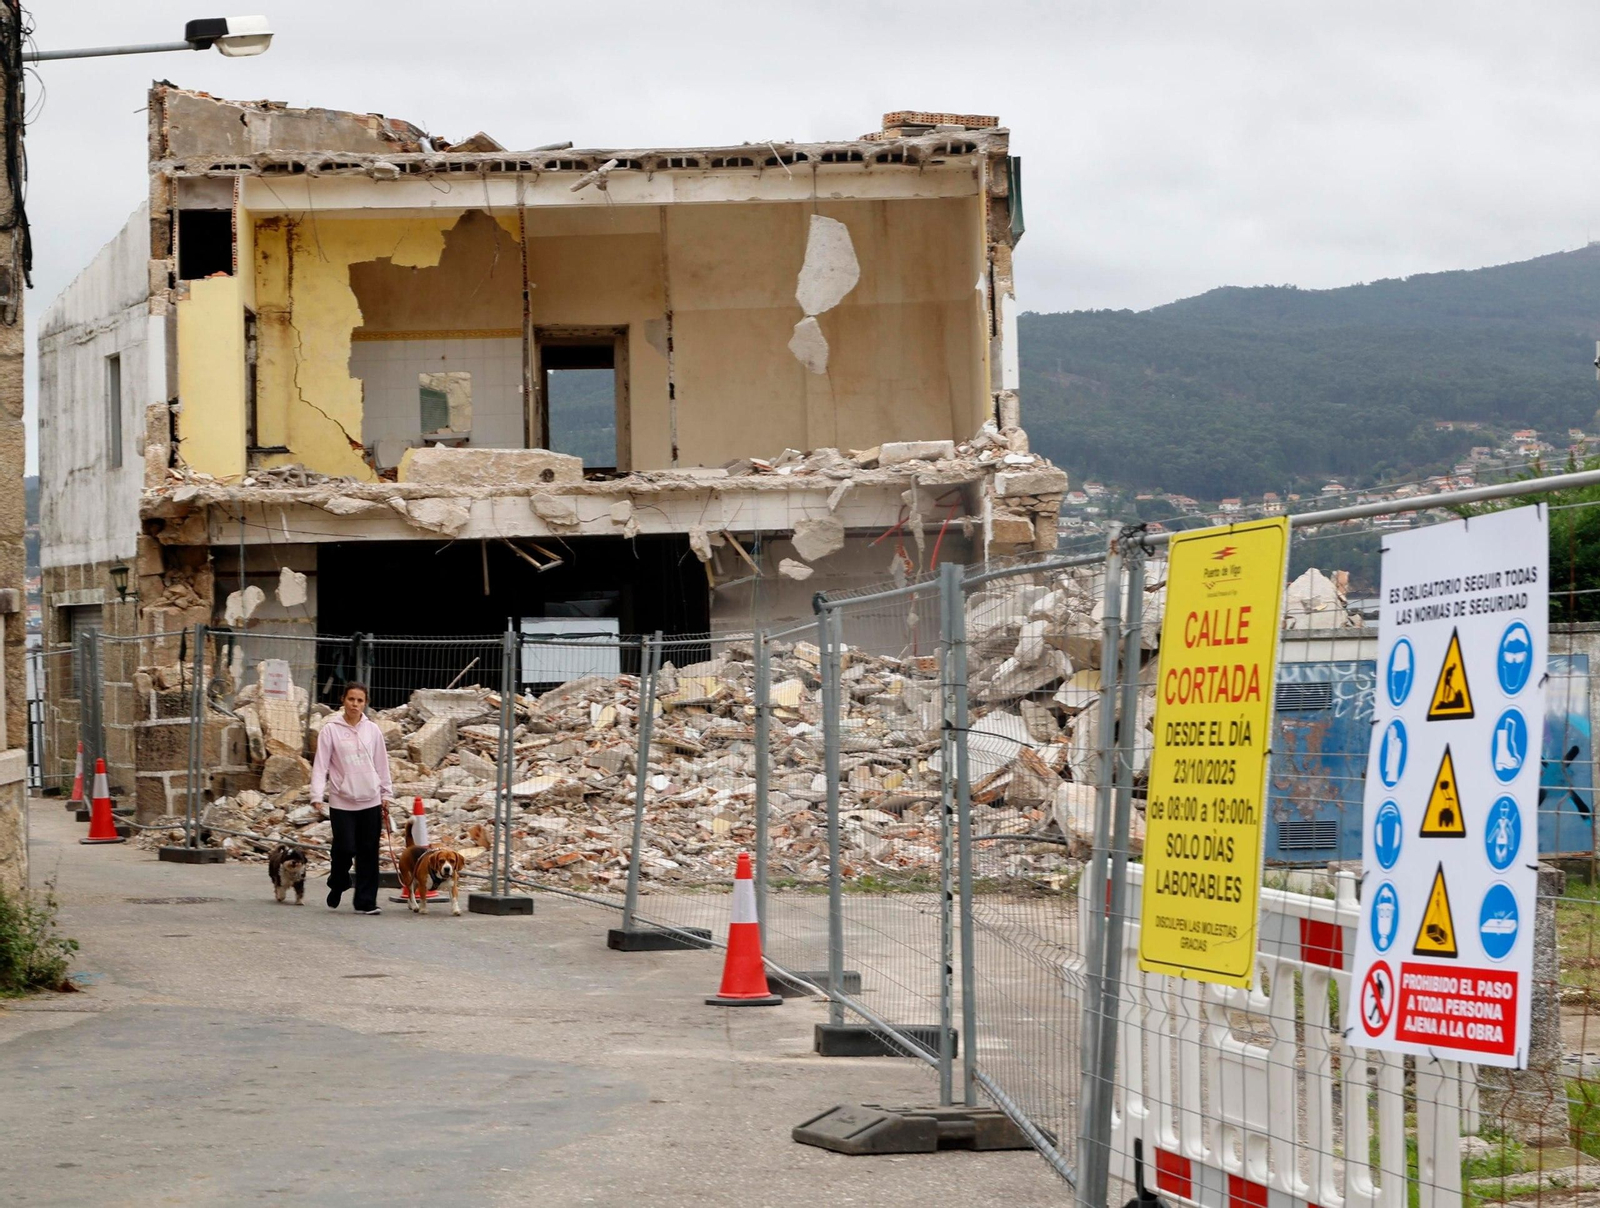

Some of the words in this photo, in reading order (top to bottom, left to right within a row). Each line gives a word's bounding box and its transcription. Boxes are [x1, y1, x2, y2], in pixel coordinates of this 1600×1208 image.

[1389, 587, 1400, 604] ES
[1402, 578, 1462, 602] OBLIGATORIO
[1463, 571, 1502, 592] SEGUIR
[1504, 565, 1538, 586] TODAS
[1396, 609, 1412, 626] LAS
[1413, 602, 1451, 623] NORMAS
[1453, 600, 1466, 617] DE
[1468, 592, 1529, 615] SEGURIDAD
[1184, 605, 1252, 649] CALLE
[1164, 663, 1261, 706] CORTADA
[1165, 721, 1206, 747] DESDE
[1209, 721, 1225, 747] EL
[1228, 713, 1253, 747] DÍA
[1173, 758, 1237, 785] 23/10/2025
[1150, 795, 1165, 820] de
[1167, 796, 1198, 822] 08:00
[1200, 803, 1208, 823] a
[1212, 797, 1257, 825] 19:00h.
[1165, 832, 1200, 860] SOLO
[1155, 869, 1242, 904] LABORABLES
[1155, 915, 1188, 932] DISCULPEN
[1188, 919, 1201, 933] LAS
[1201, 921, 1238, 939] MOLESTIAS
[1180, 936, 1208, 952] GRACIAS
[1402, 972, 1459, 995] PROHIBIDO
[1460, 978, 1475, 996] EL
[1476, 980, 1513, 1000] PASO
[1406, 993, 1416, 1011] A
[1416, 994, 1444, 1014] TODA
[1445, 998, 1503, 1021] PERSONA
[1403, 1014, 1439, 1035] AJENA
[1438, 1019, 1448, 1037] A
[1448, 1020, 1466, 1039] LA
[1466, 1022, 1505, 1043] OBRA
